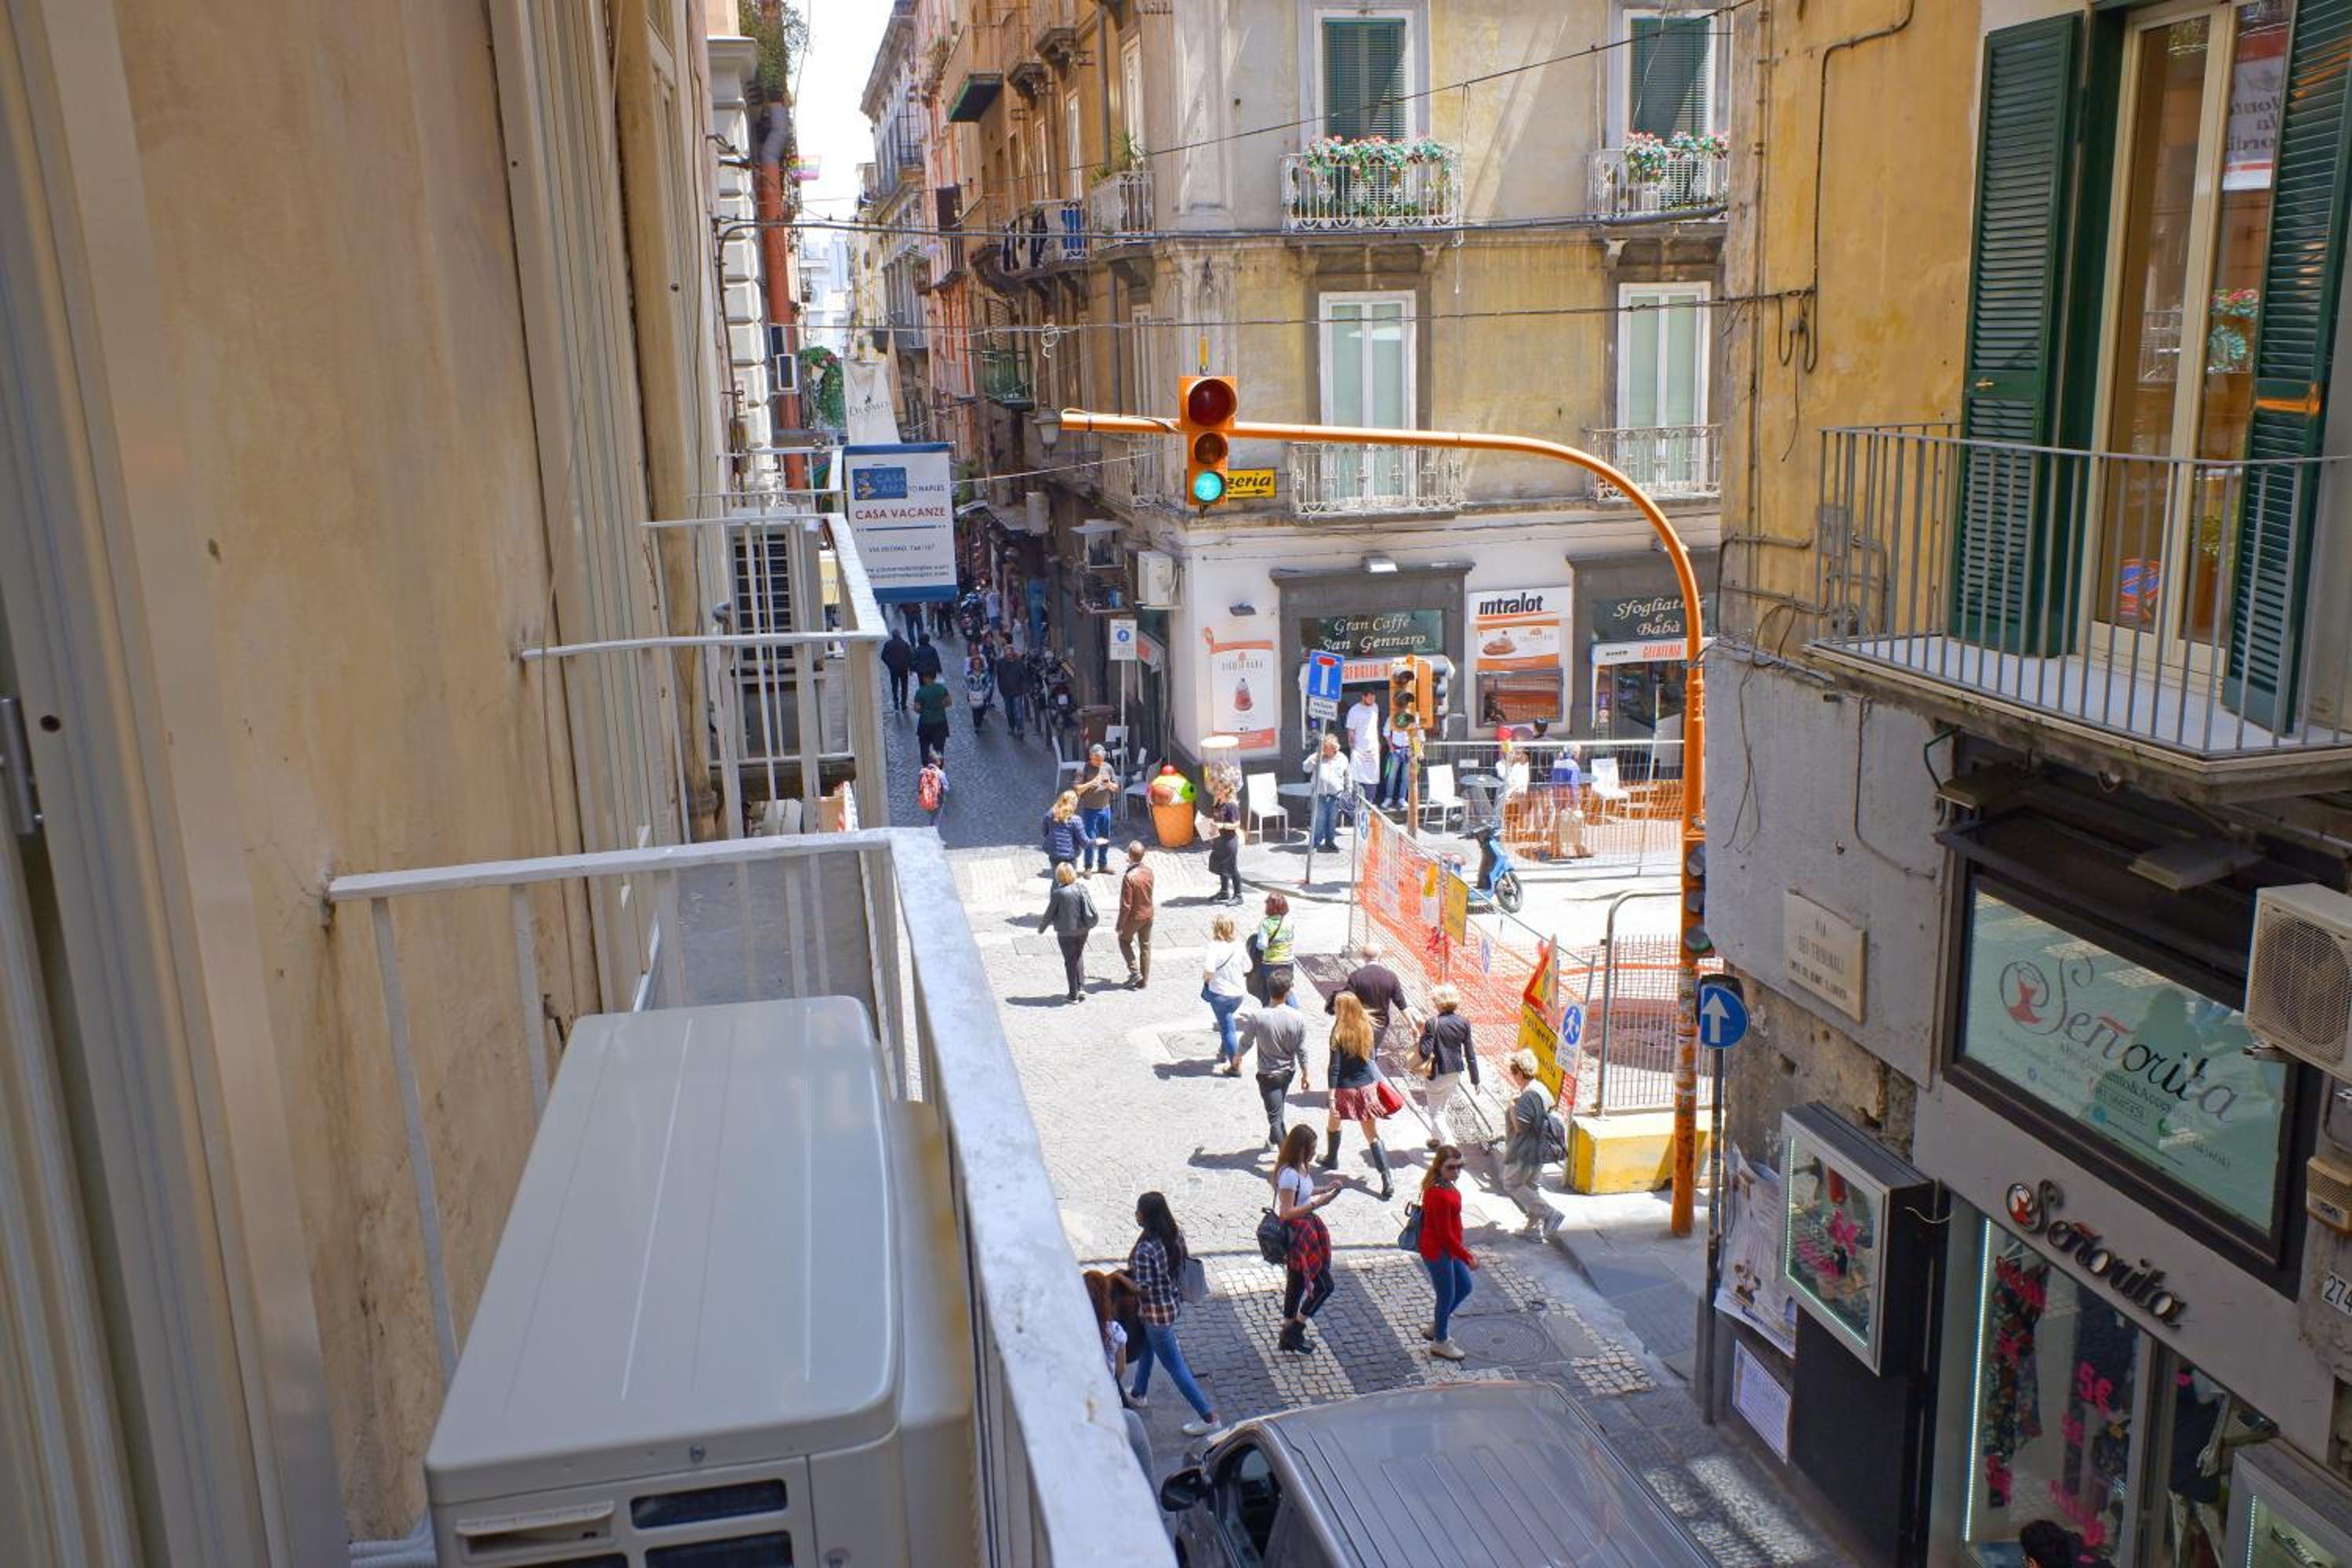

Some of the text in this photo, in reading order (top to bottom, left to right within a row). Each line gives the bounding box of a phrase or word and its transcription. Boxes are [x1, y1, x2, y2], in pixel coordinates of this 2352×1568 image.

[855, 506, 946, 520] CASA VACANZE
[1479, 593, 1544, 615] intralot
[1334, 618, 1368, 636] Gran
[1321, 634, 1426, 652] San Gennaro
[2000, 956, 2238, 1123] Señorita
[2006, 1179, 2189, 1329] Señorita
